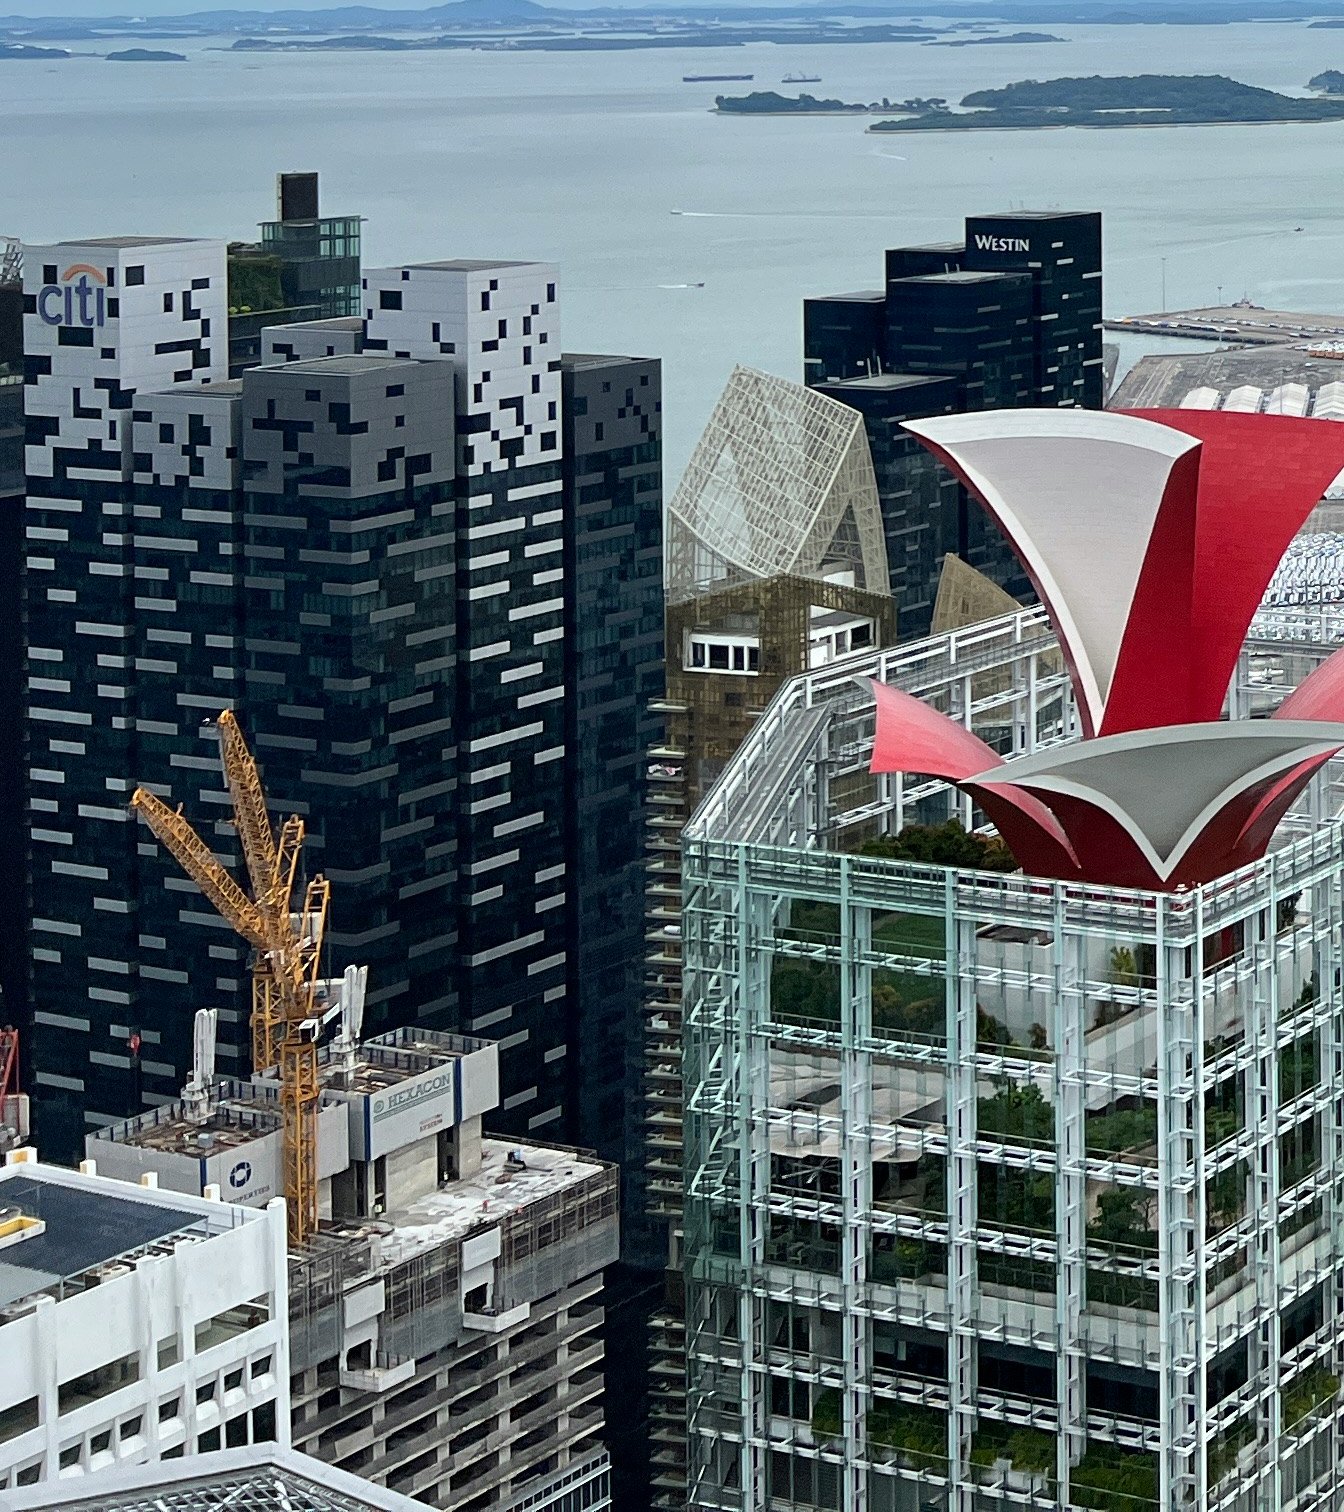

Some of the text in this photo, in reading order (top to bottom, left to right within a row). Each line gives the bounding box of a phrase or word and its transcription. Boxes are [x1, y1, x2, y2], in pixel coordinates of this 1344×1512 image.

[974, 234, 1030, 252] WESTIN
[38, 274, 105, 327] citi
[388, 1072, 451, 1109] HEXACON
